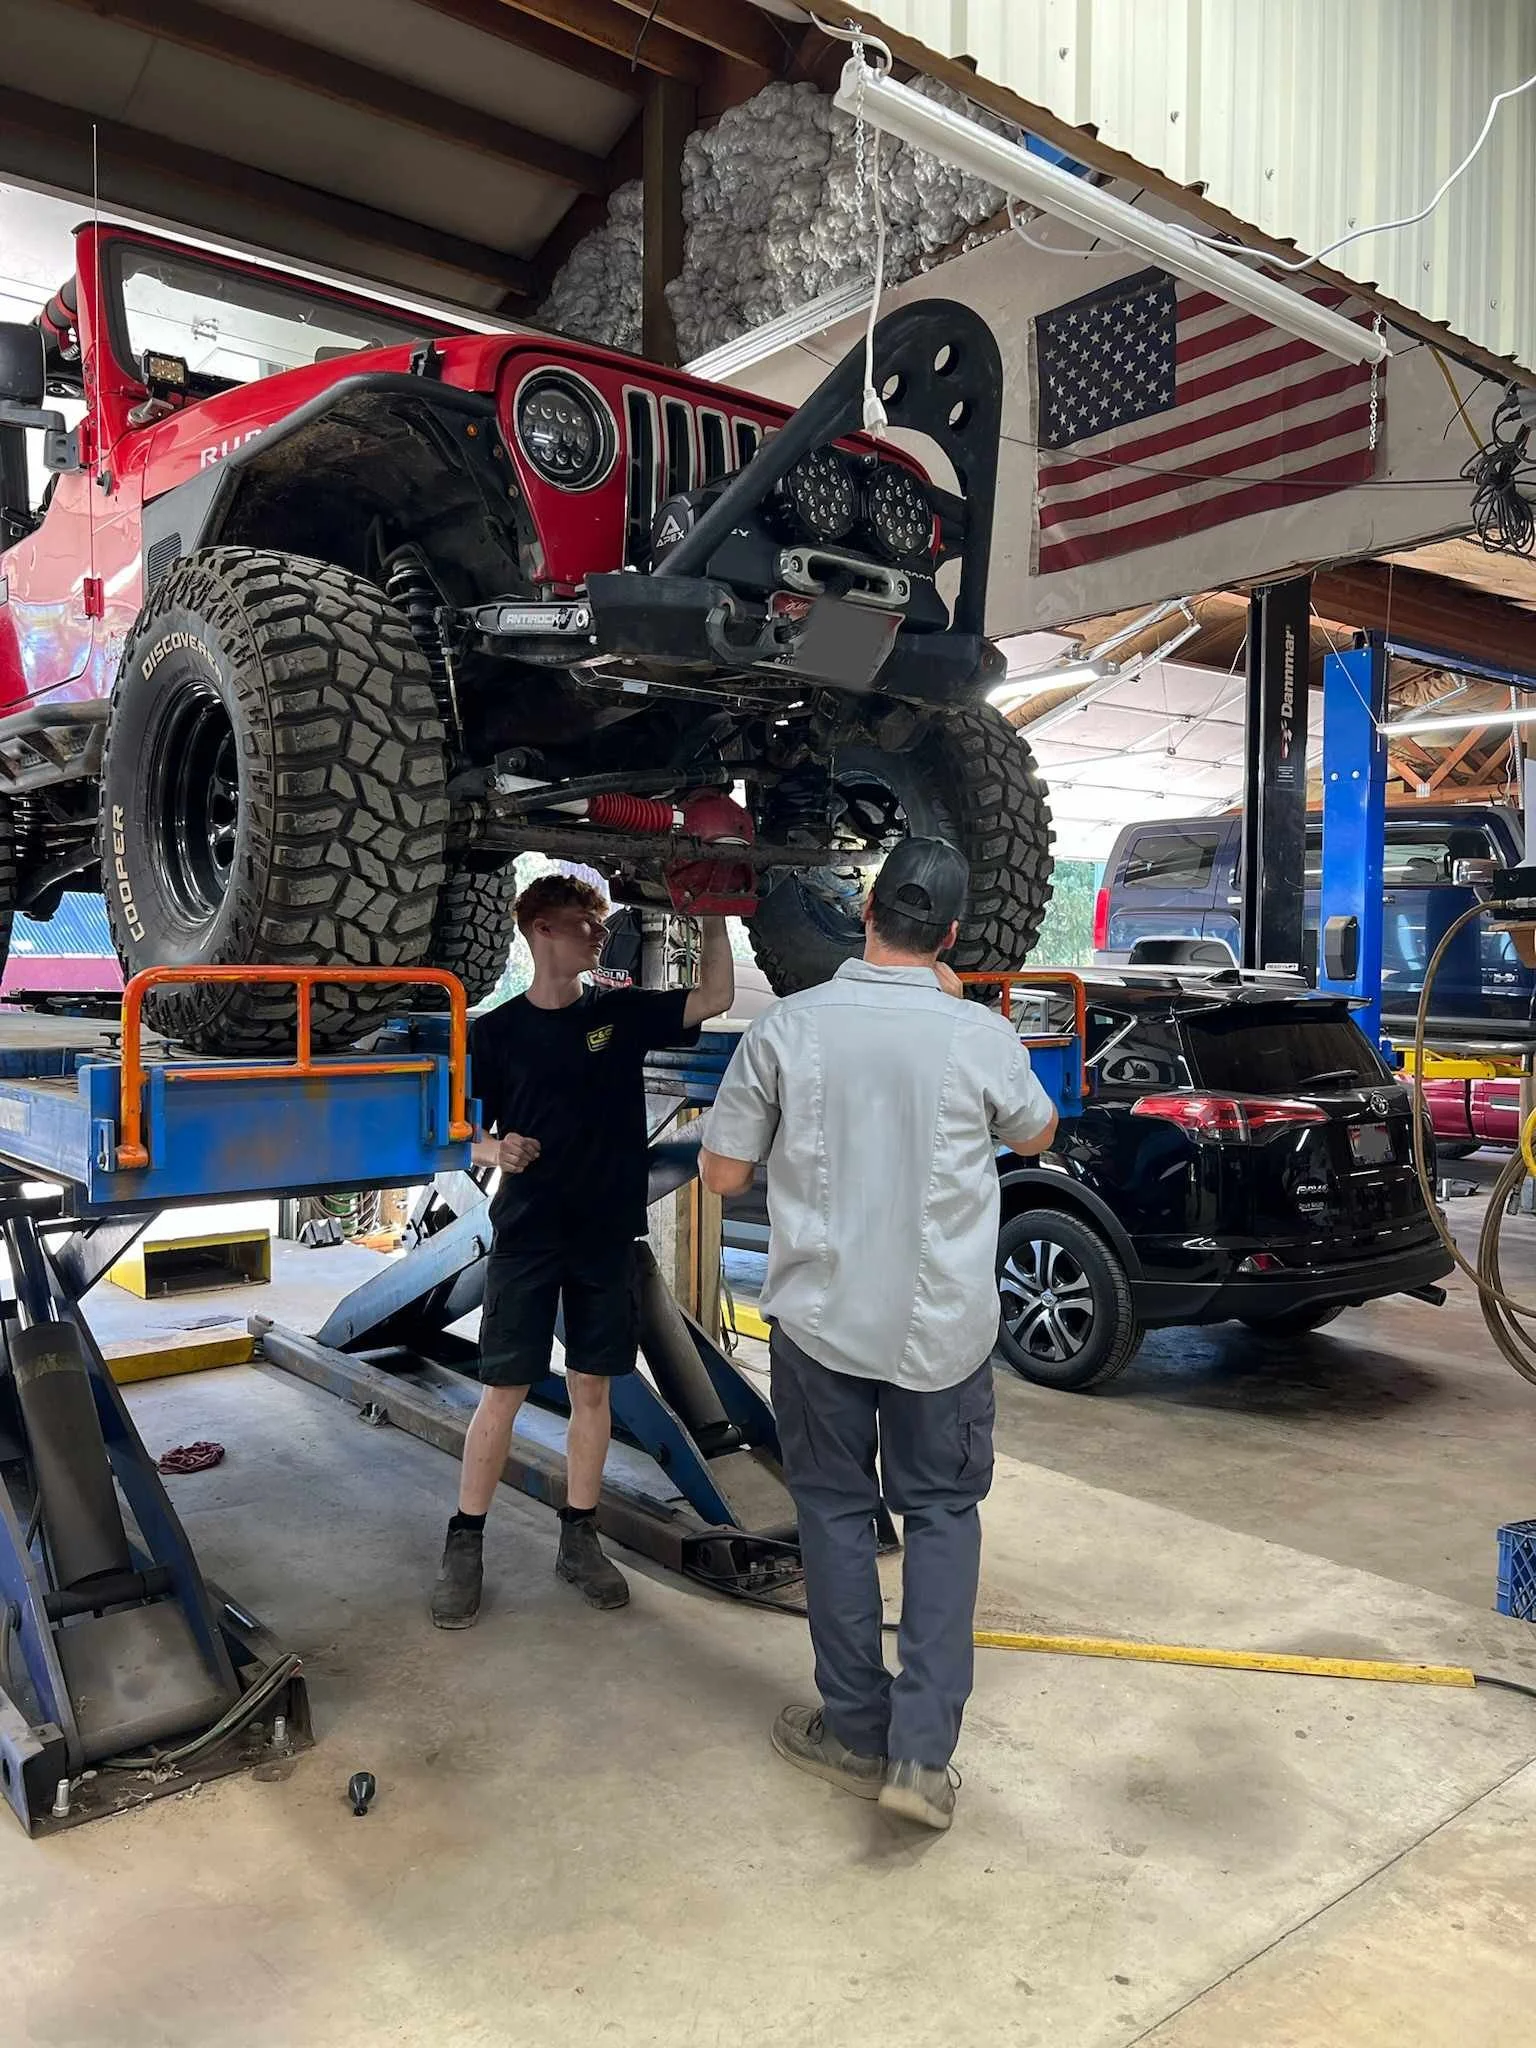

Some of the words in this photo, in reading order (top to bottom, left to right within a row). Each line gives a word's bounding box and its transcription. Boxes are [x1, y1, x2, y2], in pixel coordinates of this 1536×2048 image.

[656, 530, 685, 548] APEX
[1281, 632, 1296, 719] Dannmar
[112, 804, 146, 943] COOPER
